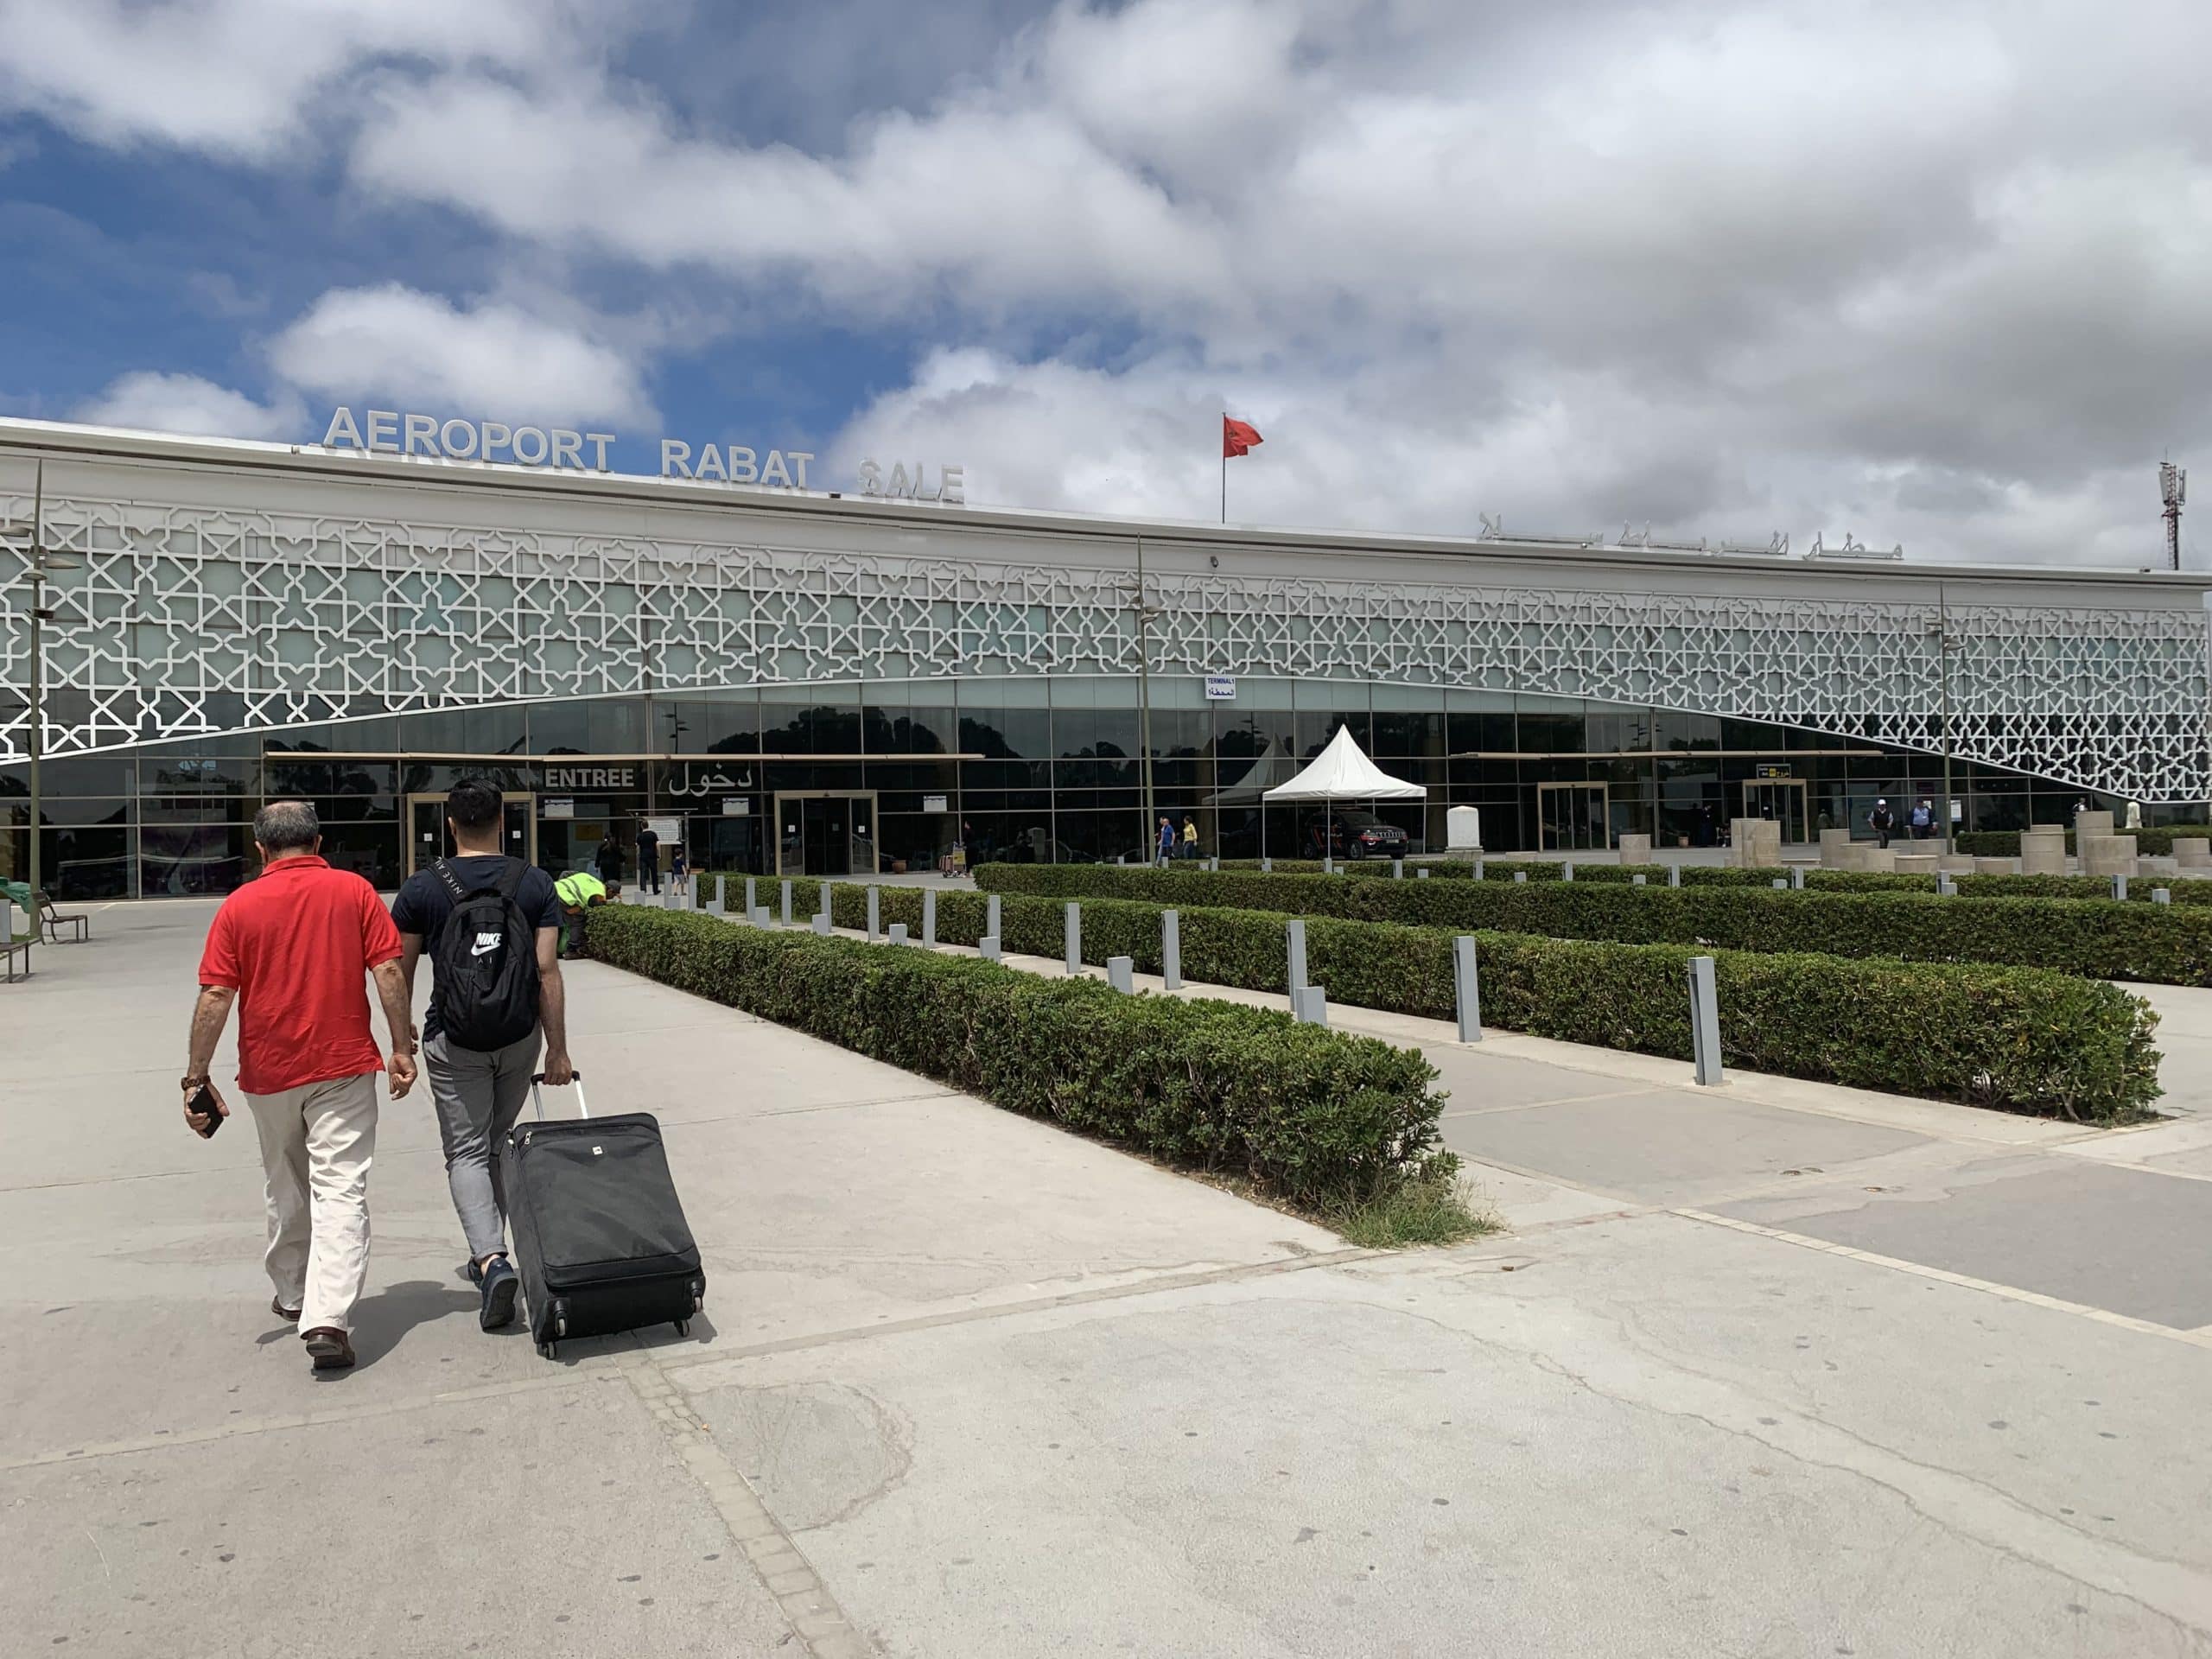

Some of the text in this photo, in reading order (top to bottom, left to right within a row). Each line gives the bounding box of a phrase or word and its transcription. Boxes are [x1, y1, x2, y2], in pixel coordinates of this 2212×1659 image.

[322, 406, 965, 504] AEROPORT RABAT SALE
[545, 768, 635, 788] ENTREE
[669, 760, 753, 797] دخول
[442, 871, 463, 894] NIKE
[476, 932, 502, 946] NIKE
